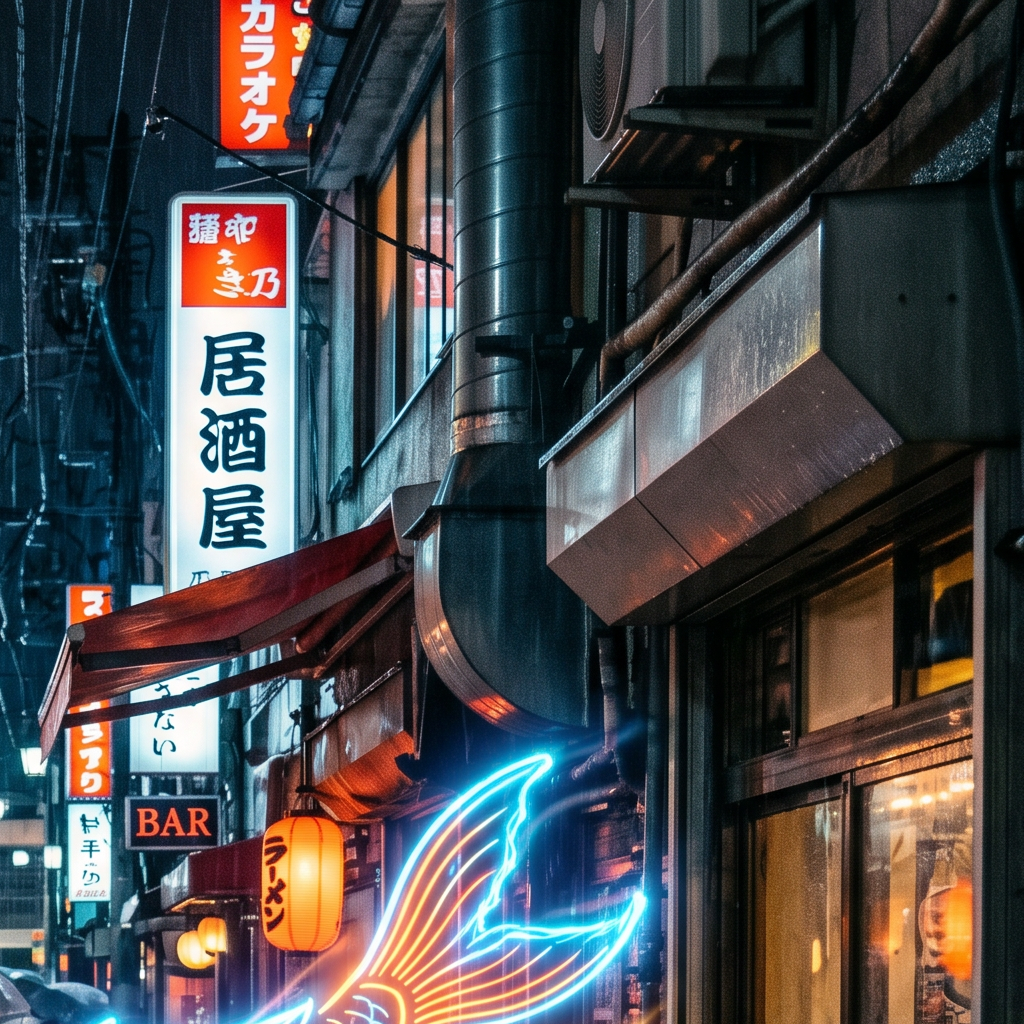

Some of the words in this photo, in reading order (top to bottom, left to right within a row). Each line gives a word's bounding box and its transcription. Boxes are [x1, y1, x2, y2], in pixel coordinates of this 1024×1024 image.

[240, 0, 277, 143] カラオケ
[199, 331, 267, 549] 居酒屋
[136, 807, 212, 837] BAR
[264, 836, 288, 933] ラーメン
